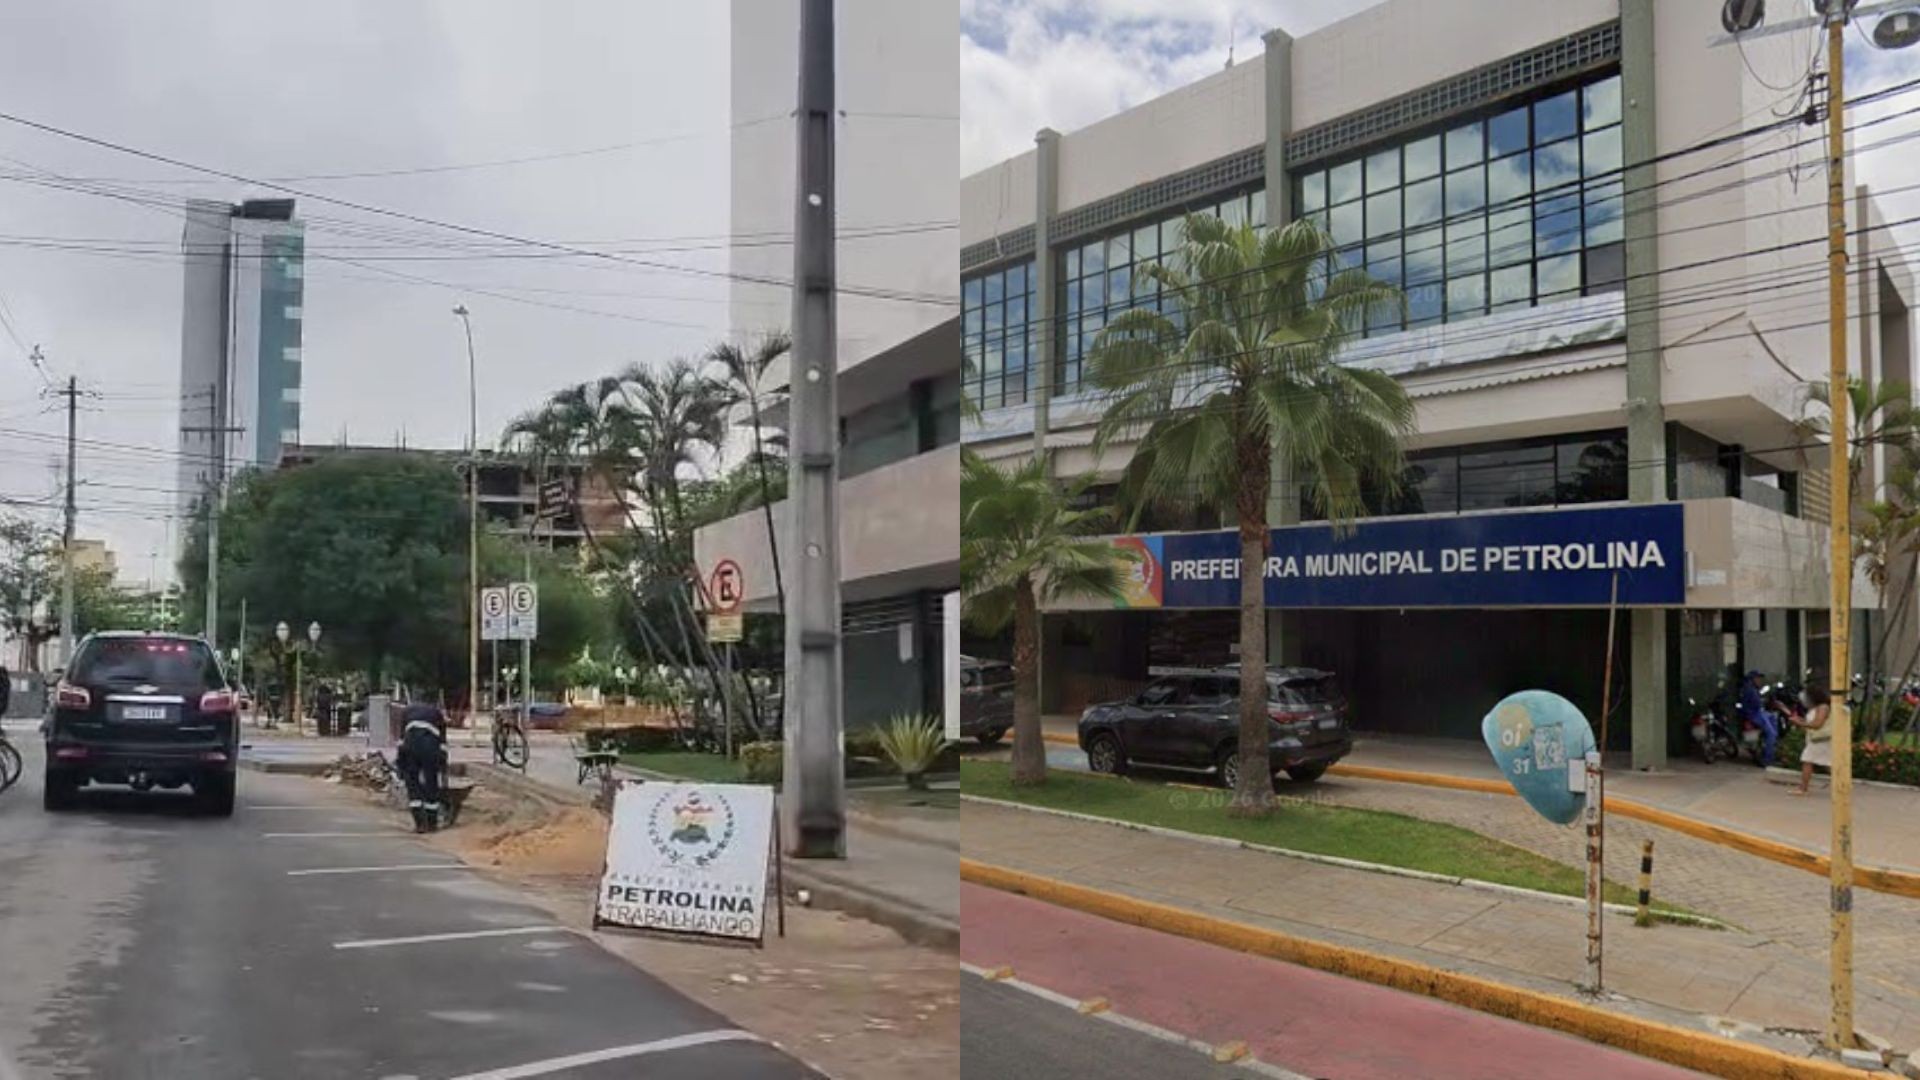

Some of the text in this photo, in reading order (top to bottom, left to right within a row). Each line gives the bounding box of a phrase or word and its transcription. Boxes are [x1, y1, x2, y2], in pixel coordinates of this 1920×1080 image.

[1305, 550, 1433, 577] MUNICIPAL
[1440, 548, 1477, 572] DE
[1484, 540, 1666, 572] PETROLINA
[490, 595, 499, 612] E
[518, 591, 528, 609] E
[1513, 758, 1531, 775] 31
[607, 884, 755, 914] PETROLINA
[606, 903, 755, 935] TRABALHANDO
